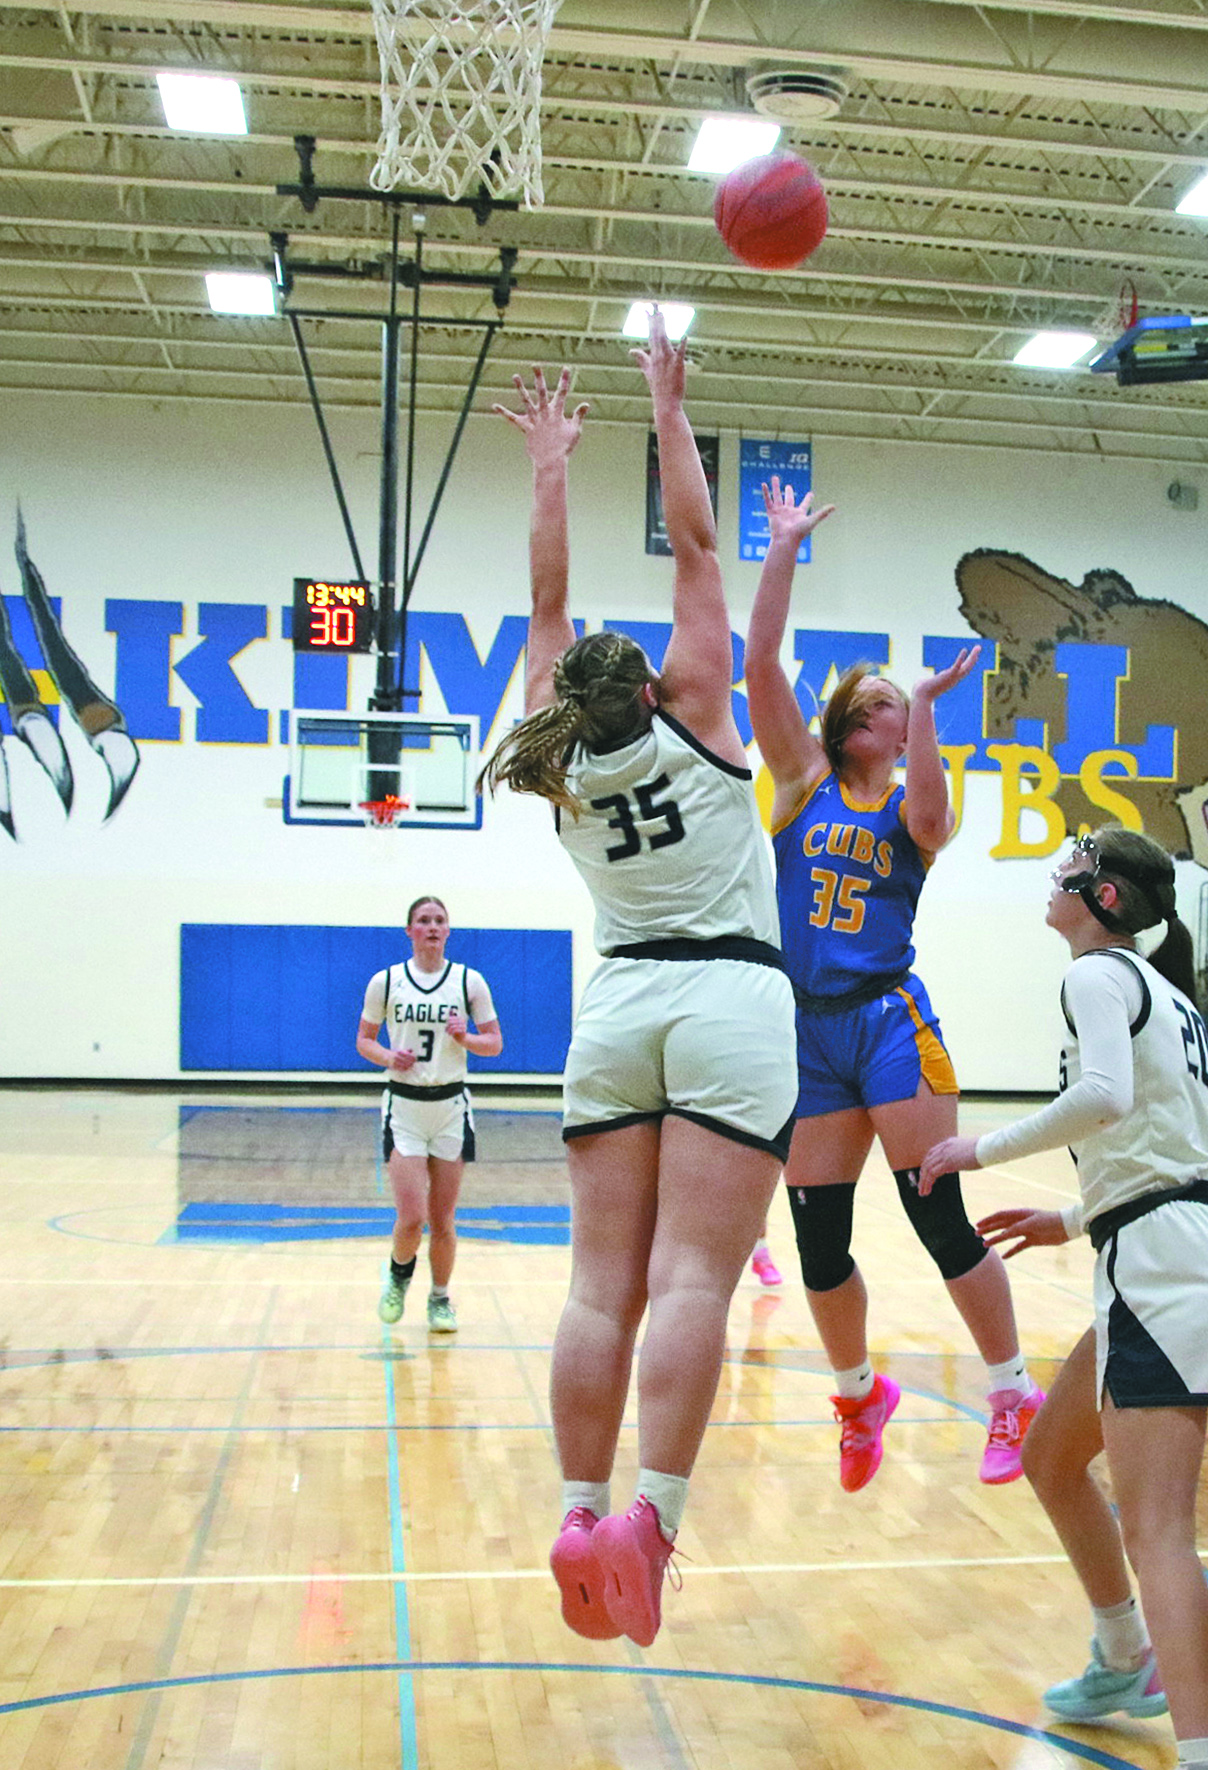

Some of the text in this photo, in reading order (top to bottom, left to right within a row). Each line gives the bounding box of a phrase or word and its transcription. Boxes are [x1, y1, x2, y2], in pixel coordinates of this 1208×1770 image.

[306, 583, 366, 607] 13:44
[309, 607, 356, 647] 30
[104, 598, 1179, 783] KIMLL
[590, 771, 687, 863] 35
[754, 743, 1144, 860] BS
[802, 822, 894, 879] CUBS
[808, 866, 872, 935] 35
[416, 1029, 435, 1062] 3
